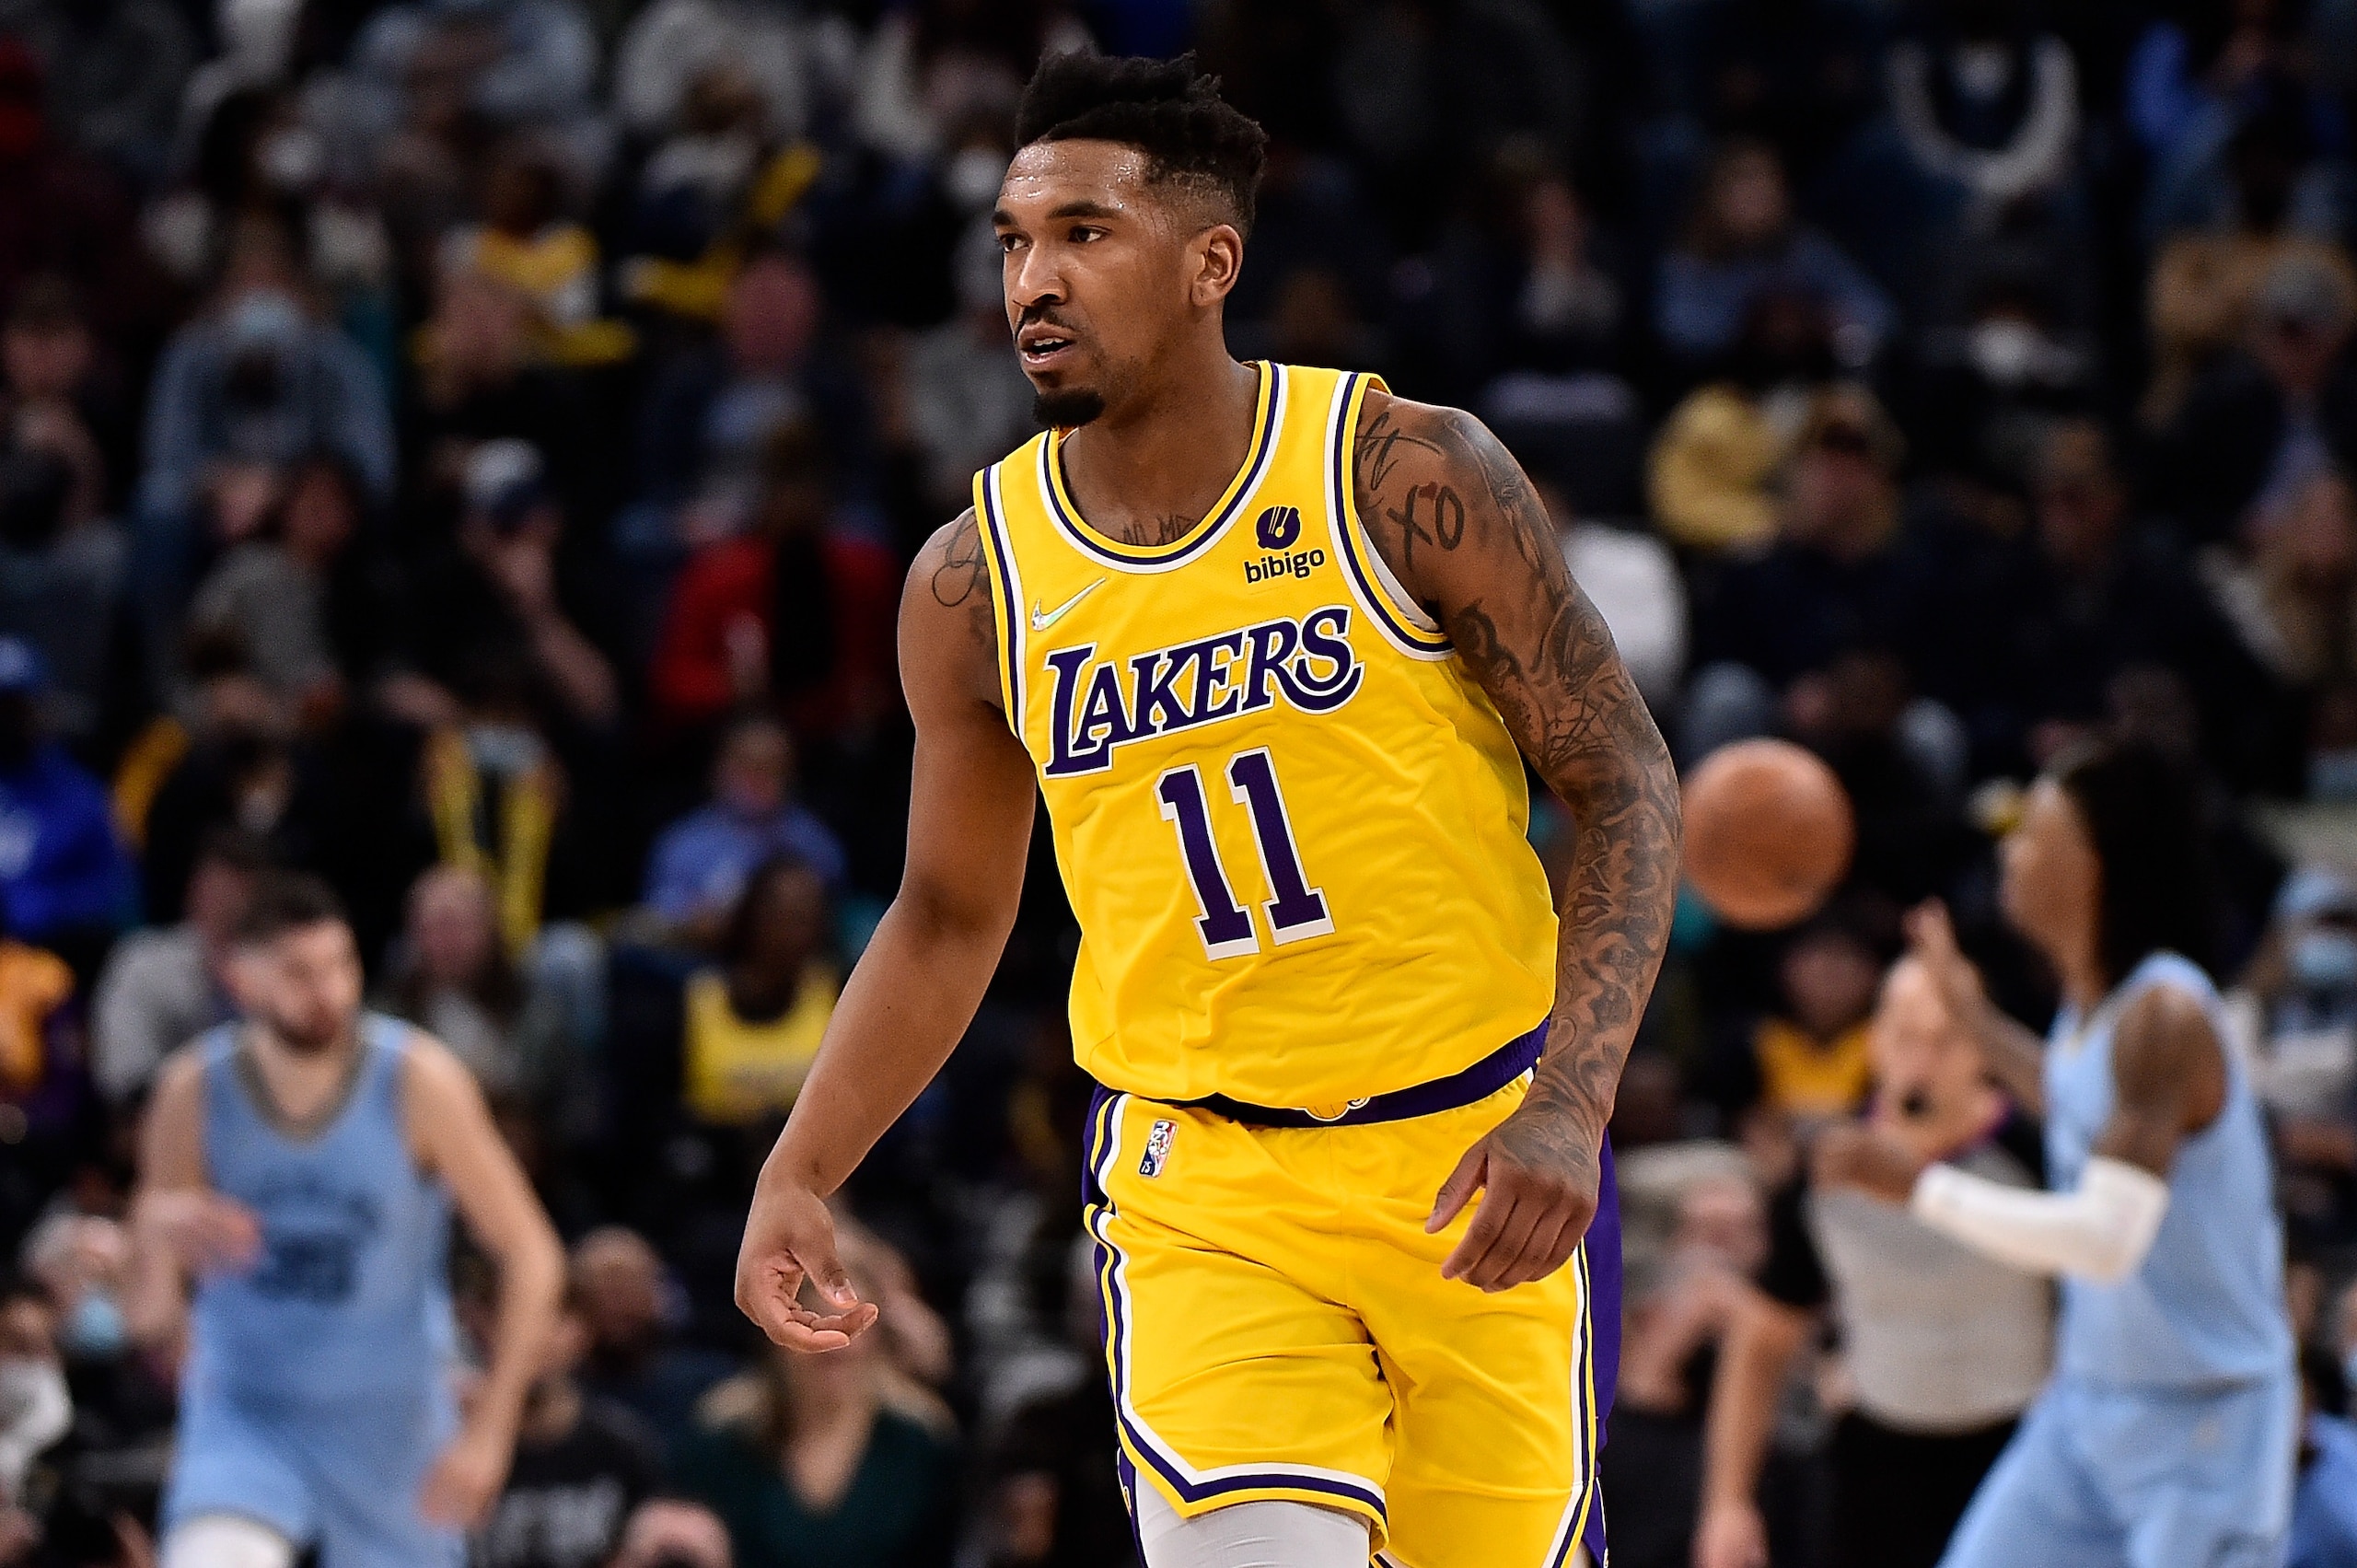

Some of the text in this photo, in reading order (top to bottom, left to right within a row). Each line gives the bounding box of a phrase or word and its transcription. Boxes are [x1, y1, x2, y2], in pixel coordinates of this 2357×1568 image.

[1244, 549, 1325, 584] bibigo
[1044, 605, 1364, 778] LAKERS
[1155, 746, 1335, 961] 11
